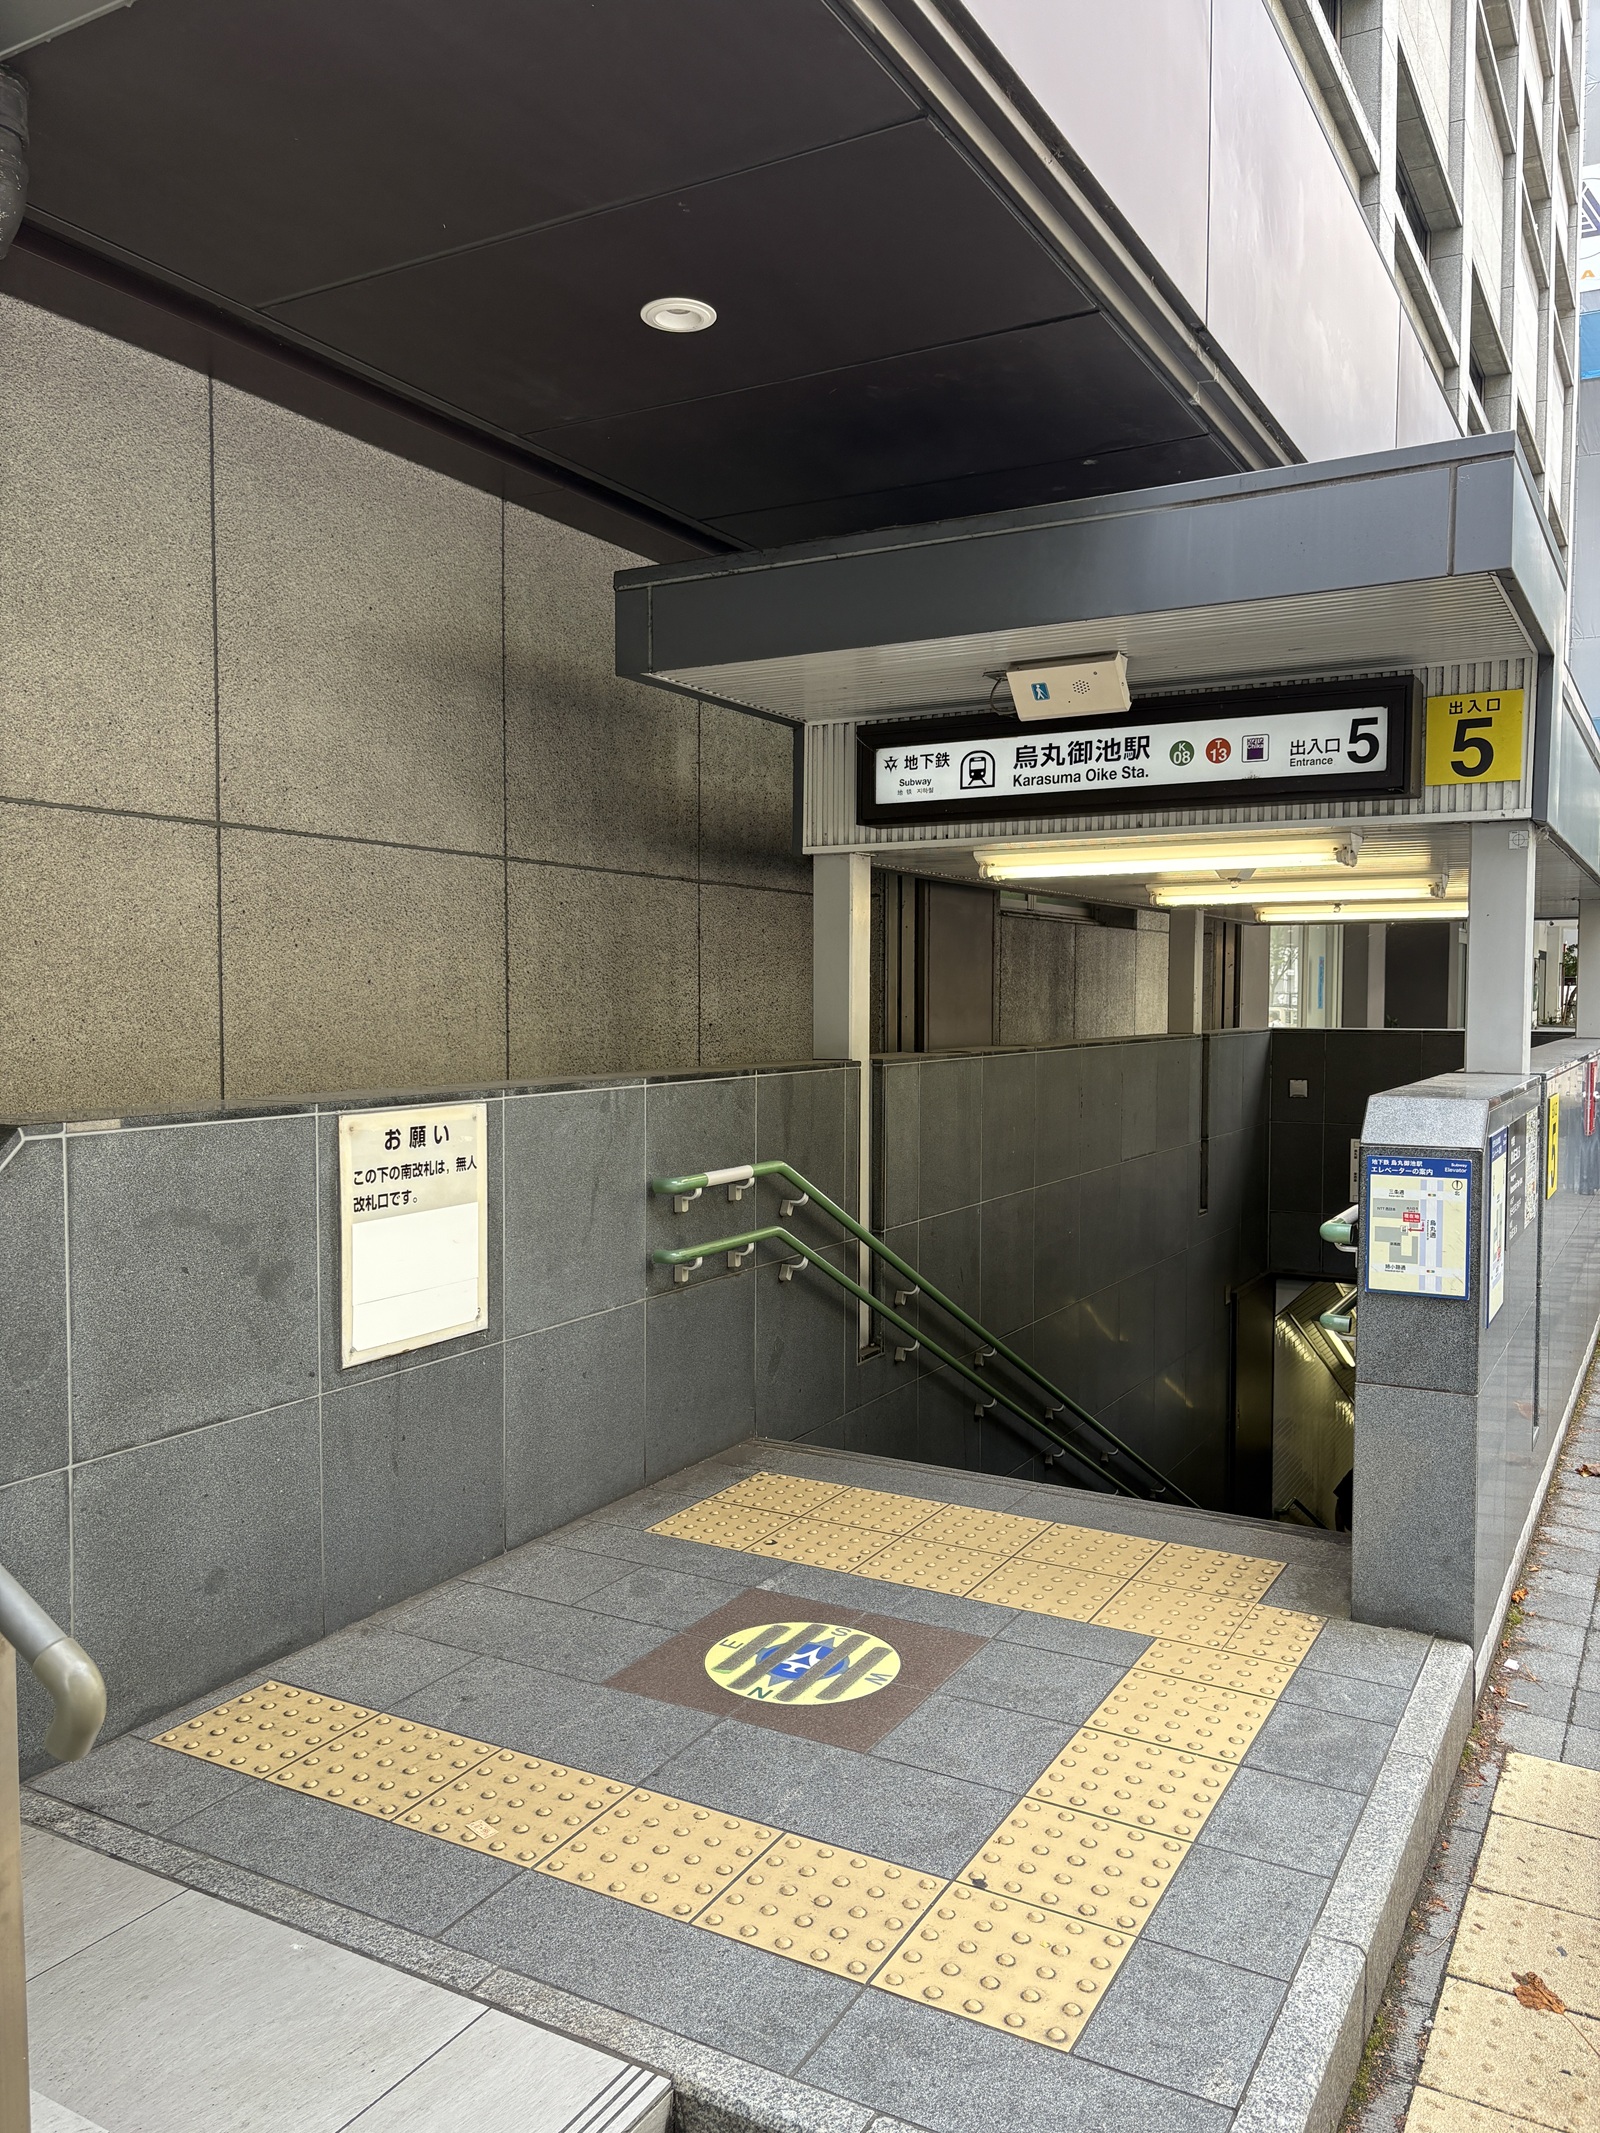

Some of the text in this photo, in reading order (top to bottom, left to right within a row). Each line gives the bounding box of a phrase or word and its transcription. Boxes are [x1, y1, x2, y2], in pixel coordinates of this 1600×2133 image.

[1449, 697, 1501, 715] 出入口
[1178, 742, 1186, 752] K
[1215, 739, 1223, 749] T
[1289, 738, 1341, 757] 出入口
[1347, 716, 1380, 764] 5
[1450, 716, 1495, 778] 5
[1013, 735, 1151, 770] 烏丸御池駅
[1173, 750, 1191, 764] 08
[1210, 747, 1228, 762] 13
[904, 752, 950, 770] 地下鉄
[1289, 757, 1334, 768] Entrance
[899, 778, 932, 787] Subway
[1013, 765, 1149, 787] Karasuma Oike Sta.
[384, 1125, 450, 1151] お願い
[1370, 1166, 1434, 1176] エレベーターの案内
[353, 1189, 418, 1213] 改札口です。
[830, 1627, 853, 1638] S
[719, 1638, 745, 1650] E
[747, 1686, 774, 1699] N
